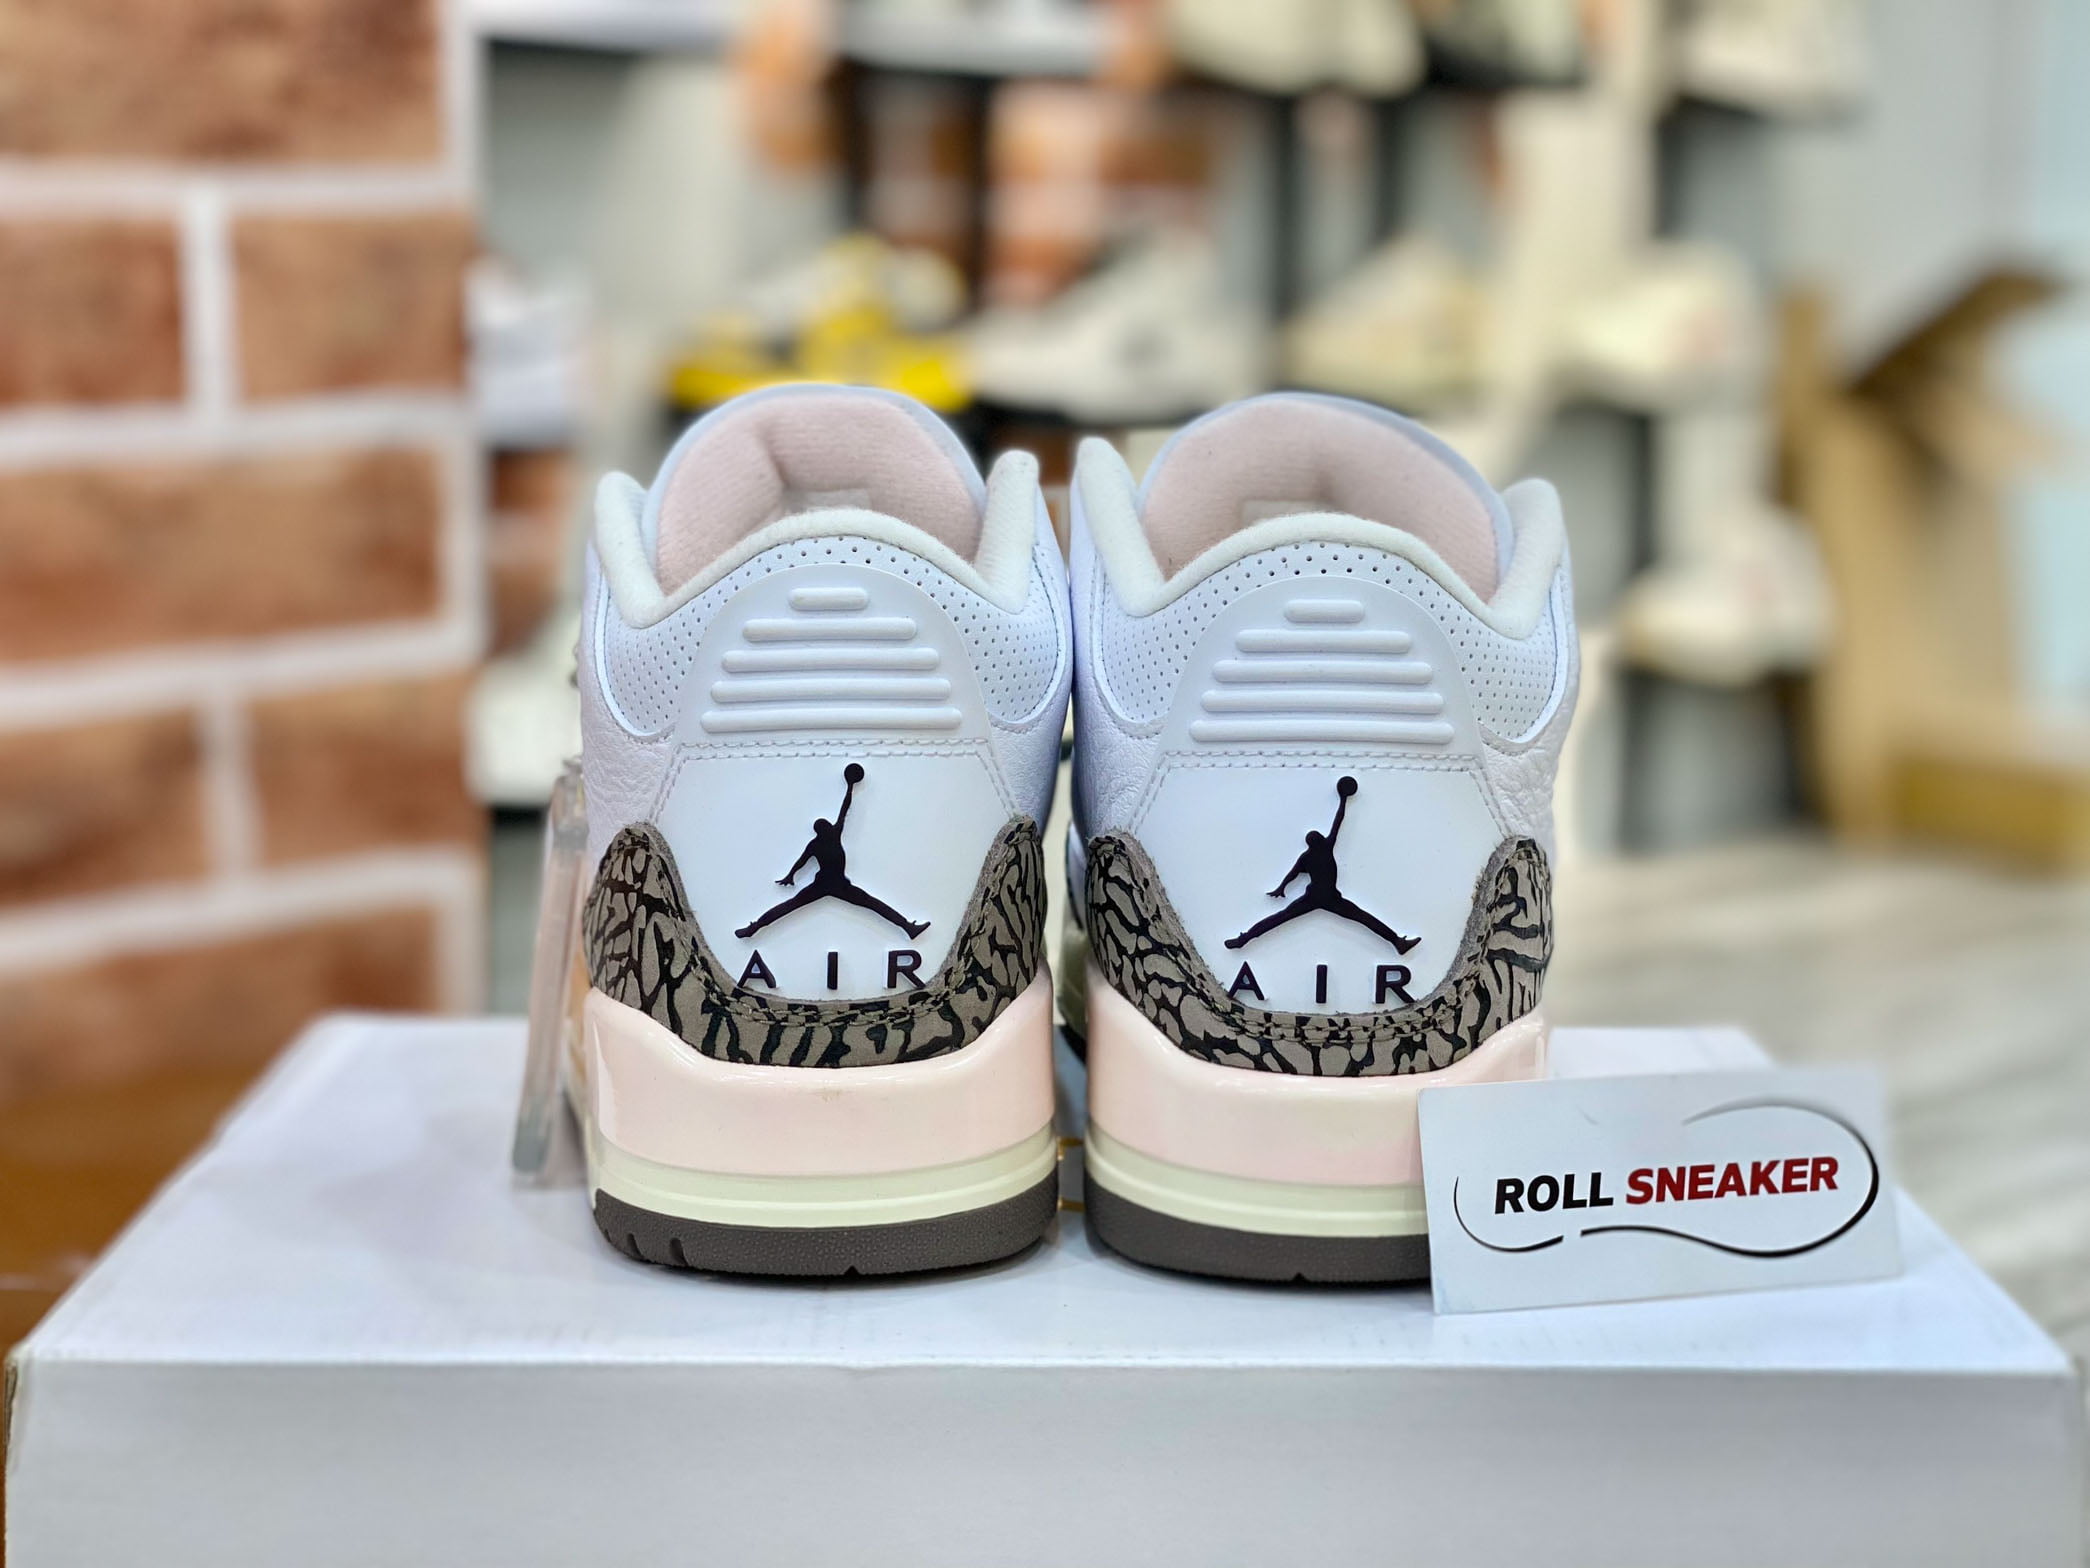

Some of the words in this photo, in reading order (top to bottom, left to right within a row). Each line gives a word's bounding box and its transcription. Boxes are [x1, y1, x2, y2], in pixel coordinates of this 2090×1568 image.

[737, 949, 926, 990] AIR
[1227, 961, 1416, 1004] AIR
[1494, 1171, 1614, 1215] ROLL
[1625, 1156, 1839, 1205] SNEAKER
